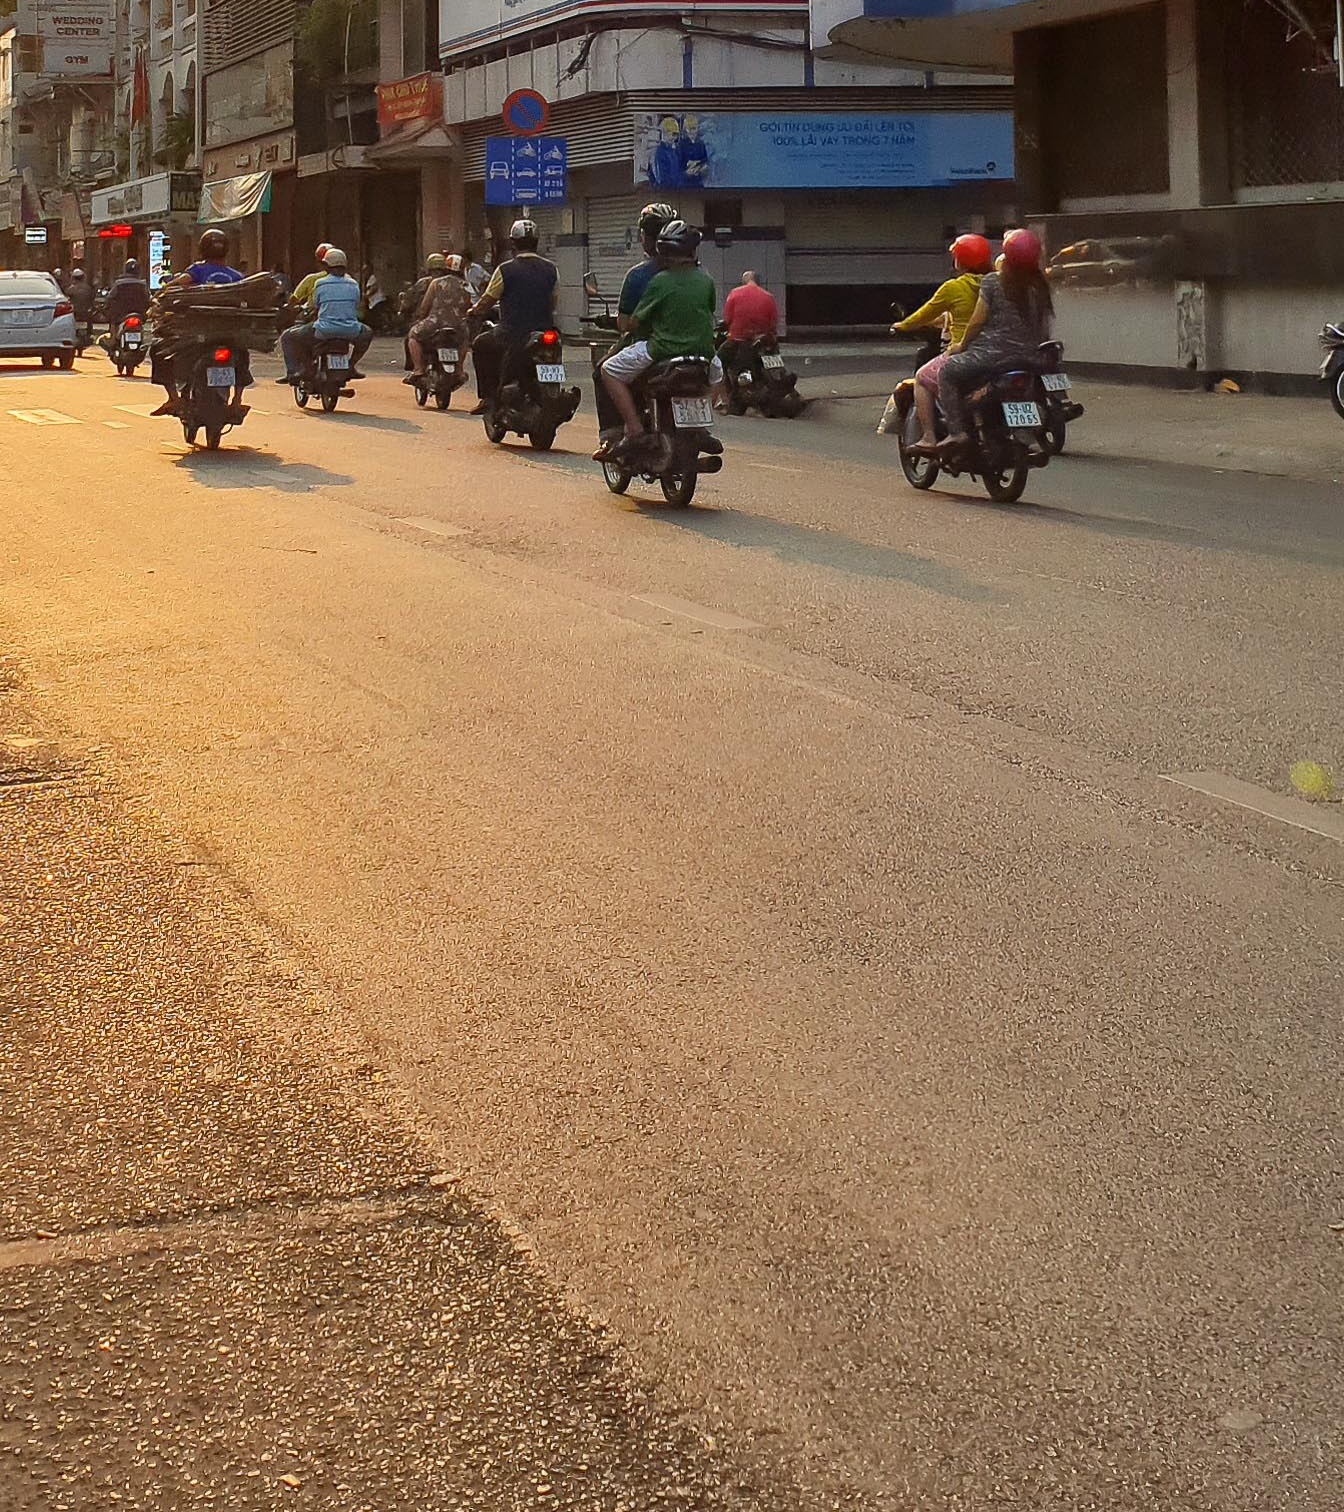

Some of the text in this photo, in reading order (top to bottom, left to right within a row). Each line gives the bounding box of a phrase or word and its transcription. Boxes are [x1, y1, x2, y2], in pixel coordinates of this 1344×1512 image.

[52, 16, 104, 25] WEDDING
[56, 27, 101, 37] CENTER
[64, 55, 89, 64] GYM
